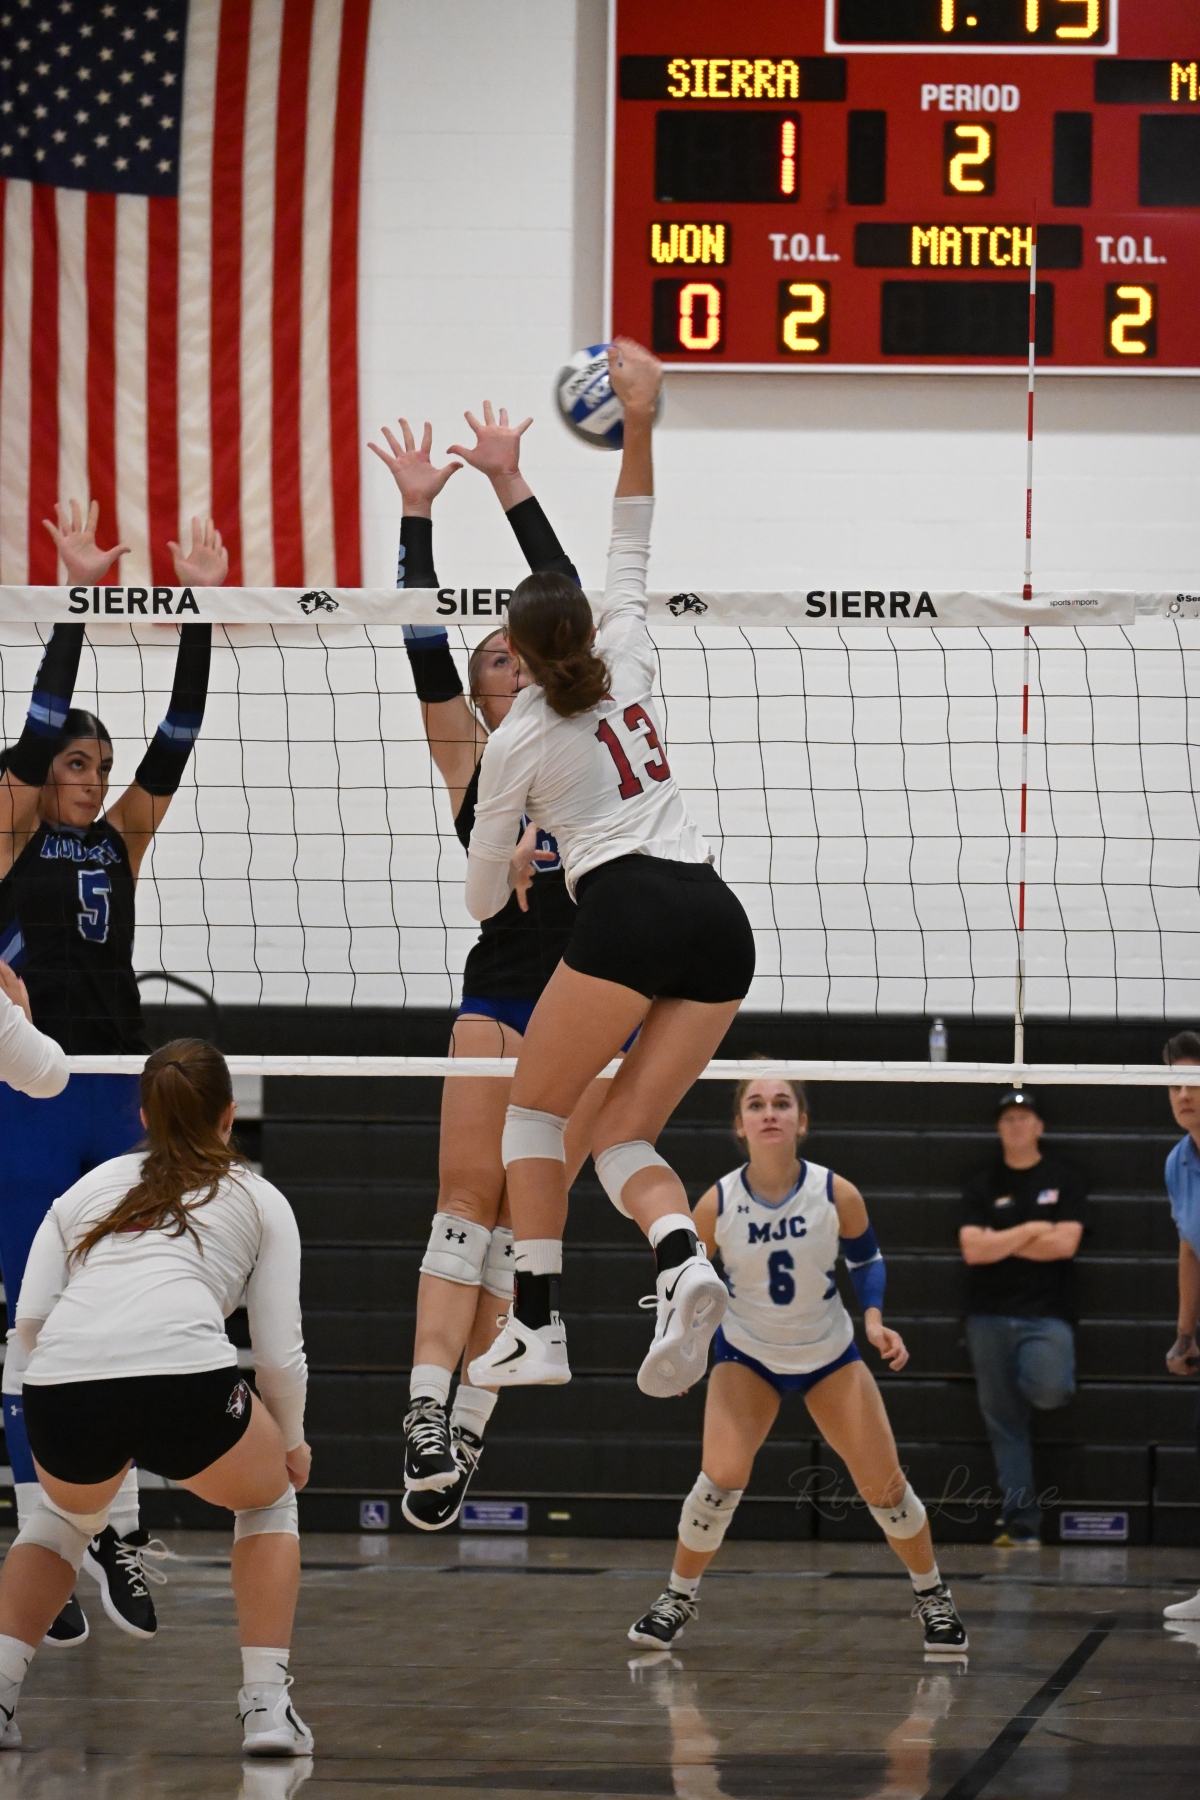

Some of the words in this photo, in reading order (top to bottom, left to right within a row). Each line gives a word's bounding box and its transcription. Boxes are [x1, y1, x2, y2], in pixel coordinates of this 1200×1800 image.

[667, 59, 799, 98] SIERRA
[921, 84, 1020, 112] PERIOD
[1171, 62, 1200, 101] M
[780, 120, 796, 194] 1
[949, 125, 991, 192] 2
[651, 224, 725, 264] WON
[769, 233, 840, 262] T.O.L.
[911, 226, 1034, 267] MATCH
[1096, 236, 1167, 264] T.O.L.
[678, 283, 721, 350] 0
[783, 284, 826, 351] 2
[1110, 286, 1153, 354] 2
[68, 586, 200, 615] SIERRA
[436, 588, 514, 616] SIER
[805, 590, 938, 618] SIERRA
[1049, 599, 1071, 607] sports
[1071, 598, 1098, 606] imports
[1185, 595, 1200, 603] Se
[594, 703, 671, 800] 13
[77, 868, 112, 944] 5
[748, 1215, 807, 1244] MJC
[768, 1249, 796, 1305] 6
